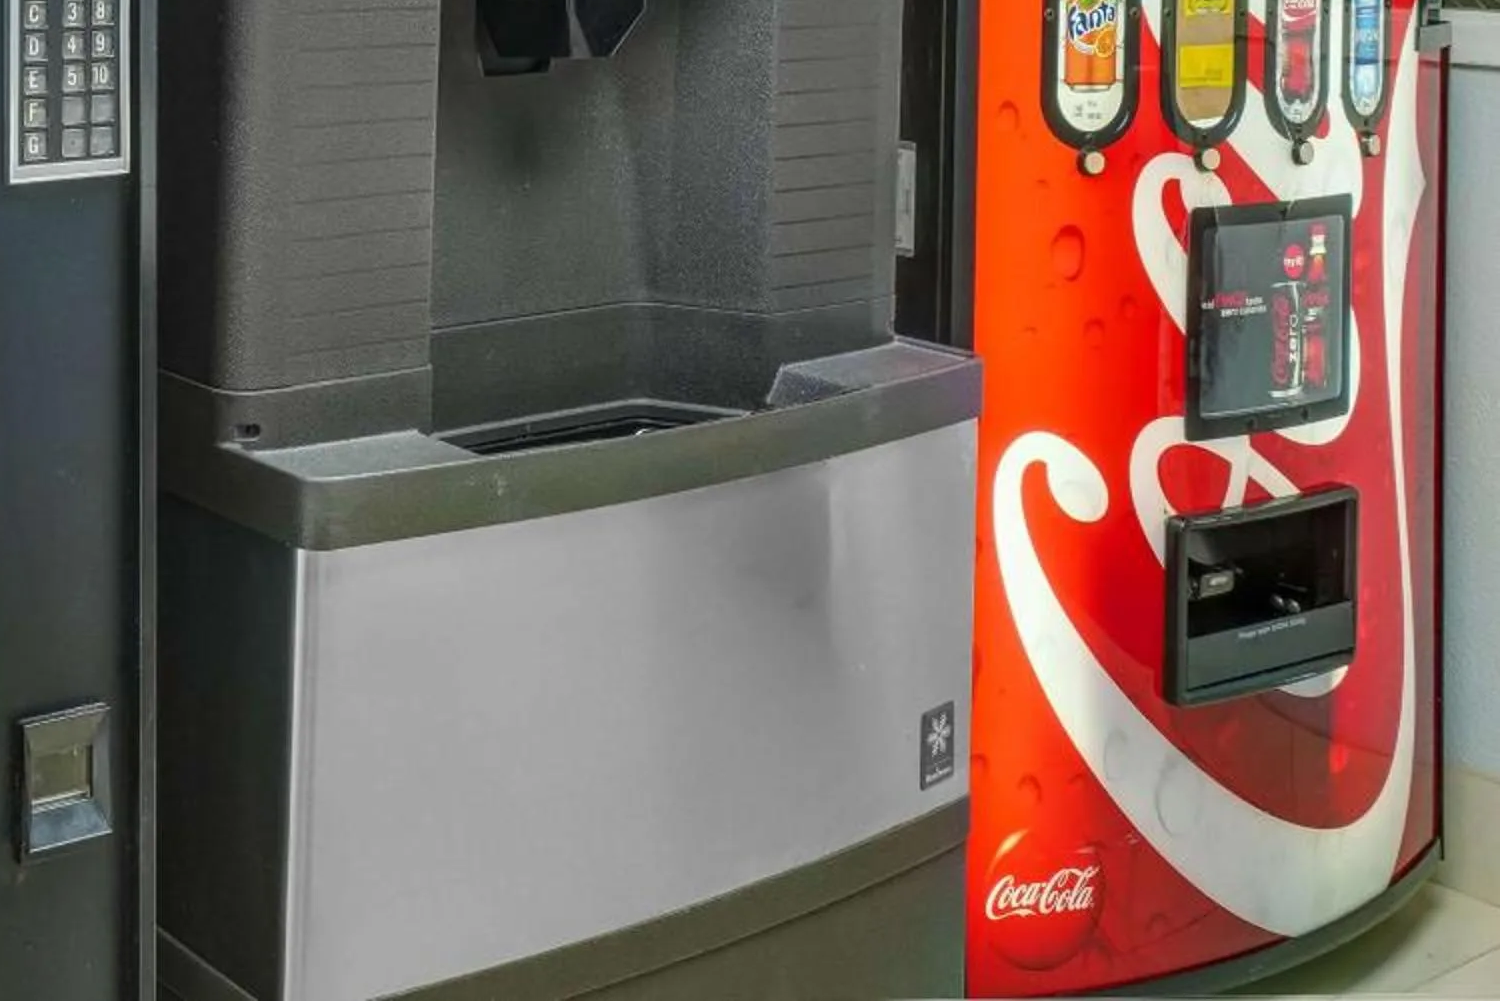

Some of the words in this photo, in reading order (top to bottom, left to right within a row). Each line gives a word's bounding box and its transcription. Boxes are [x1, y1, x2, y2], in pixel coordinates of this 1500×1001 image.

[28, 4, 39, 22] C
[67, 3, 77, 21] 3
[96, 1, 106, 19] 8
[1067, 0, 1116, 41] Fanta
[28, 37, 39, 55] D
[67, 36, 77, 53] 4
[96, 33, 106, 52] 9
[28, 70, 39, 88] E
[67, 69, 78, 86] 5
[93, 65, 108, 83] 10
[28, 102, 38, 121] F
[28, 136, 39, 154] G
[986, 865, 1100, 921] Coca-Cola
